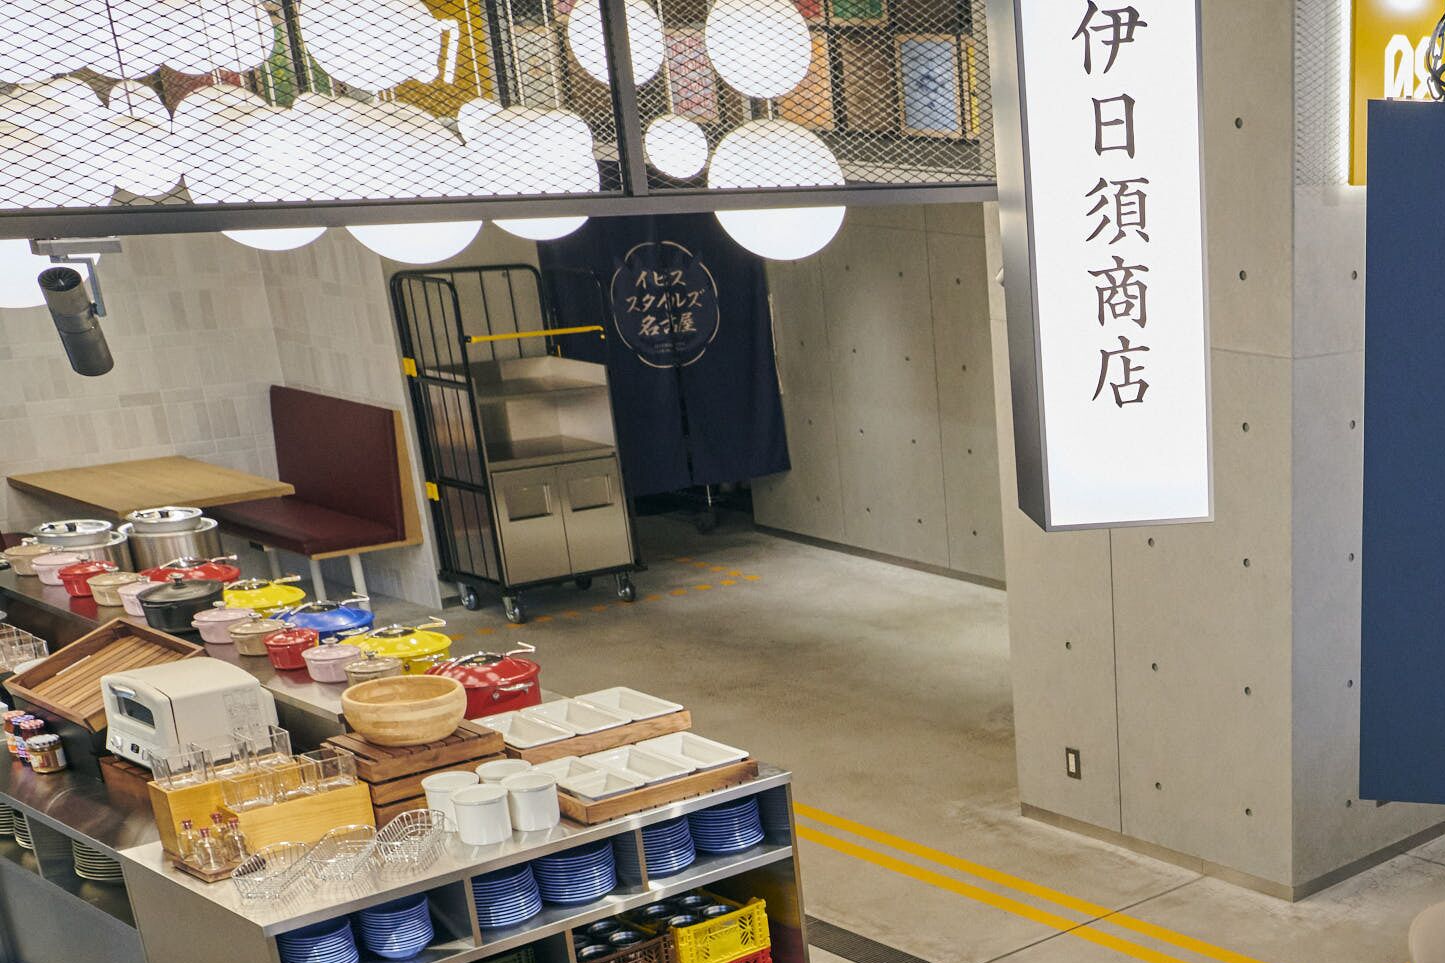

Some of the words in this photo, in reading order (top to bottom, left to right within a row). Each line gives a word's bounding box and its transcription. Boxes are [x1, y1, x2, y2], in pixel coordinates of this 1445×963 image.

[1071, 0, 1151, 409] 伊日須商店
[625, 289, 705, 313] スタイルズ
[638, 312, 697, 336] 名古屋
